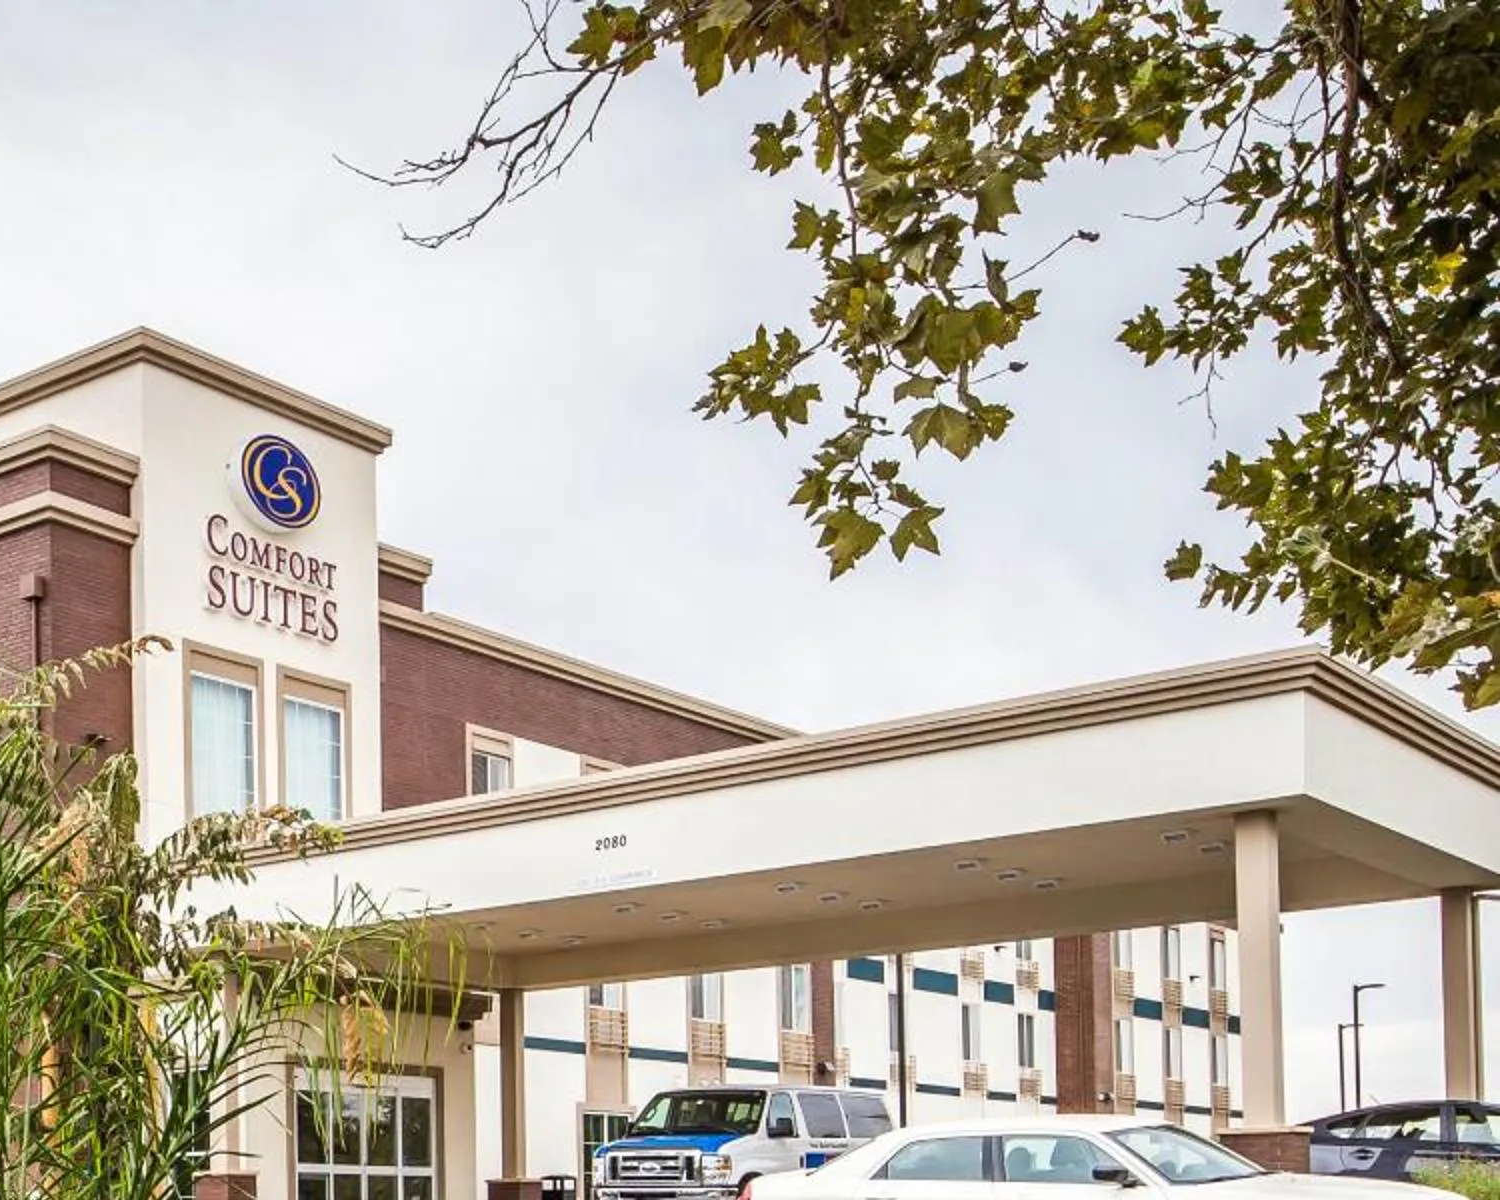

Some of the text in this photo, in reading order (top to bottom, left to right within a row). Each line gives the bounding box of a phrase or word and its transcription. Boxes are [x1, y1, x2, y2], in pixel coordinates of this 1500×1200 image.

[207, 514, 337, 591] COMFORT
[207, 565, 339, 643] SUITES
[595, 834, 627, 850] 2080
